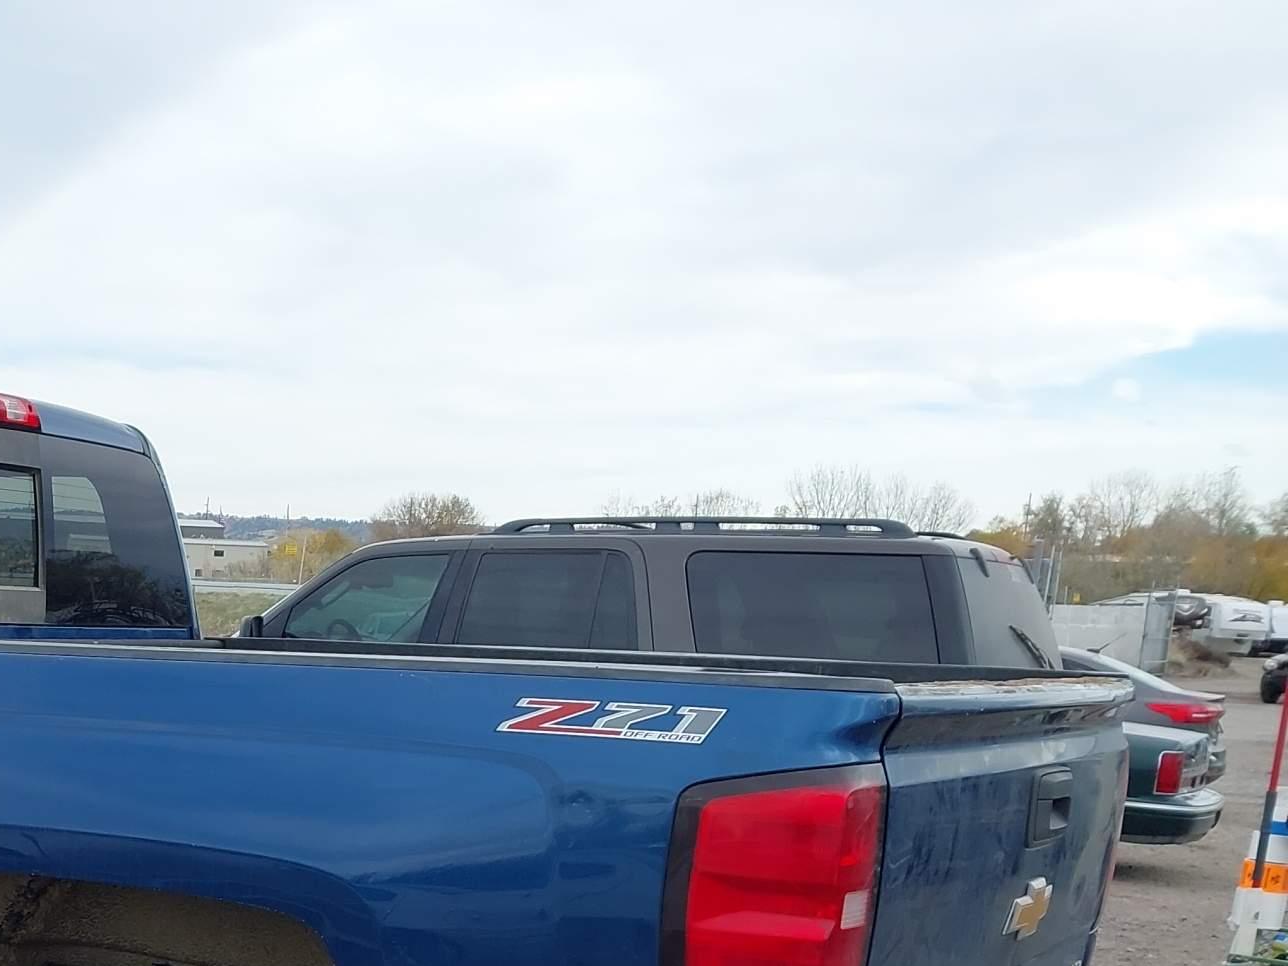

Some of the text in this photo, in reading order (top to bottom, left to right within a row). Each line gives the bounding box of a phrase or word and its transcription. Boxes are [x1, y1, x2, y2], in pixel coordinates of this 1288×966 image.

[496, 697, 727, 738] Z71
[623, 730, 702, 743] OFF ROAD
